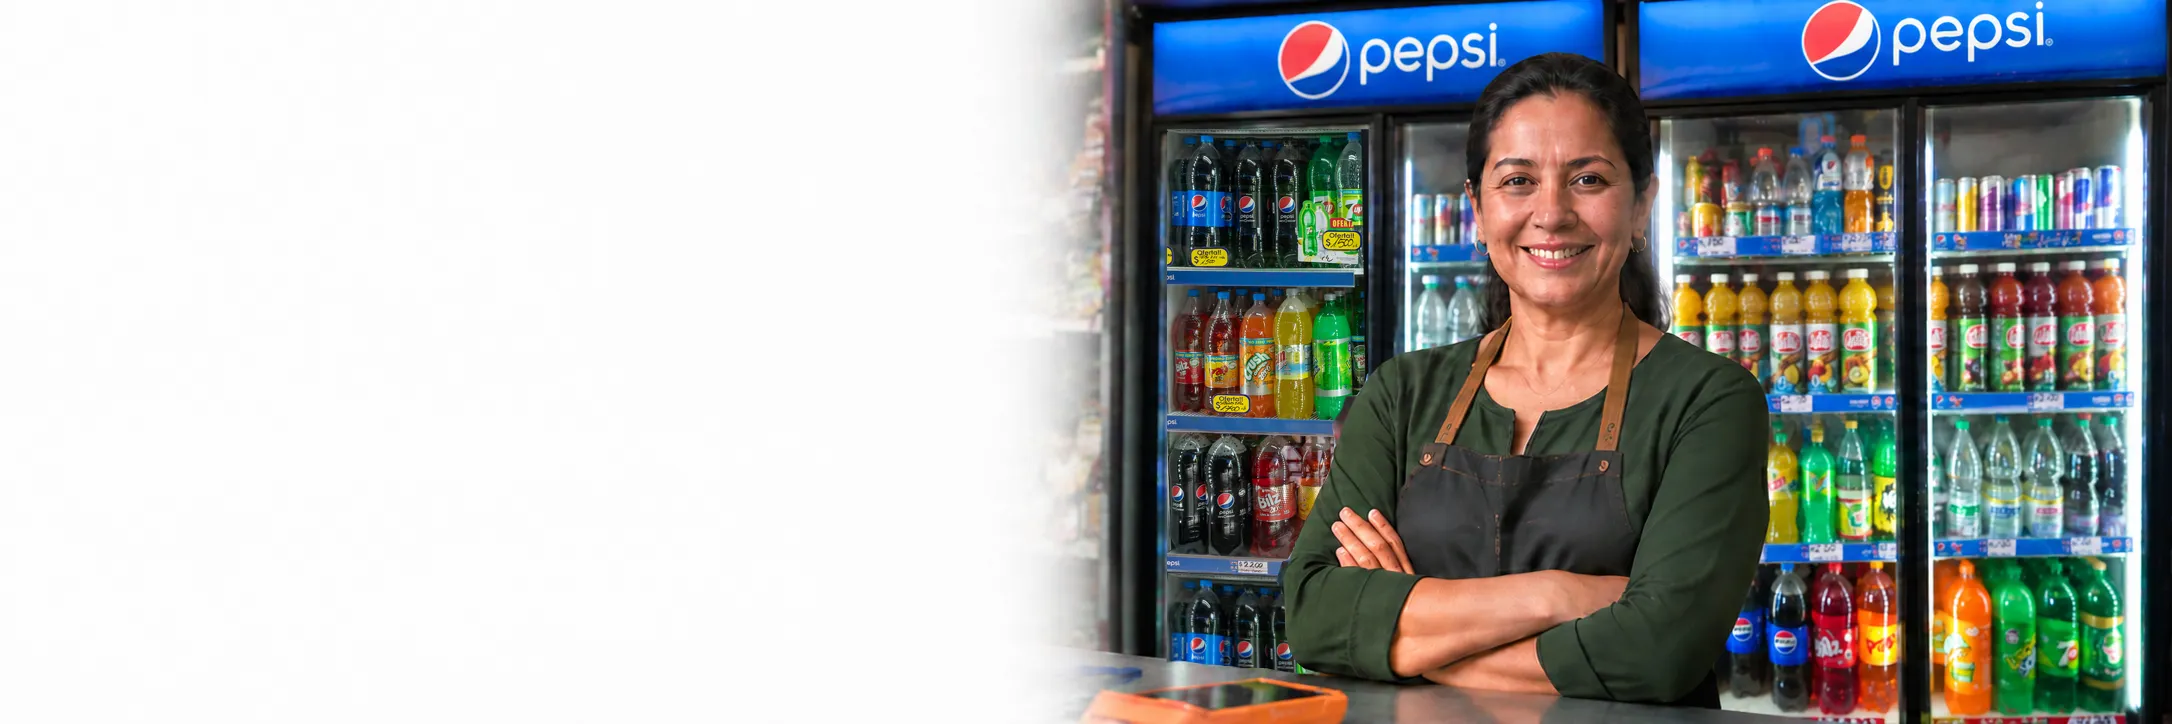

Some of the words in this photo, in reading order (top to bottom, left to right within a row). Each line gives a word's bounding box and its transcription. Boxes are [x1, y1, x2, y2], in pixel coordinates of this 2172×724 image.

[1360, 22, 1498, 86] pepsi
[1893, 1, 2044, 66] pepsi
[1258, 493, 1281, 509] Bilz
